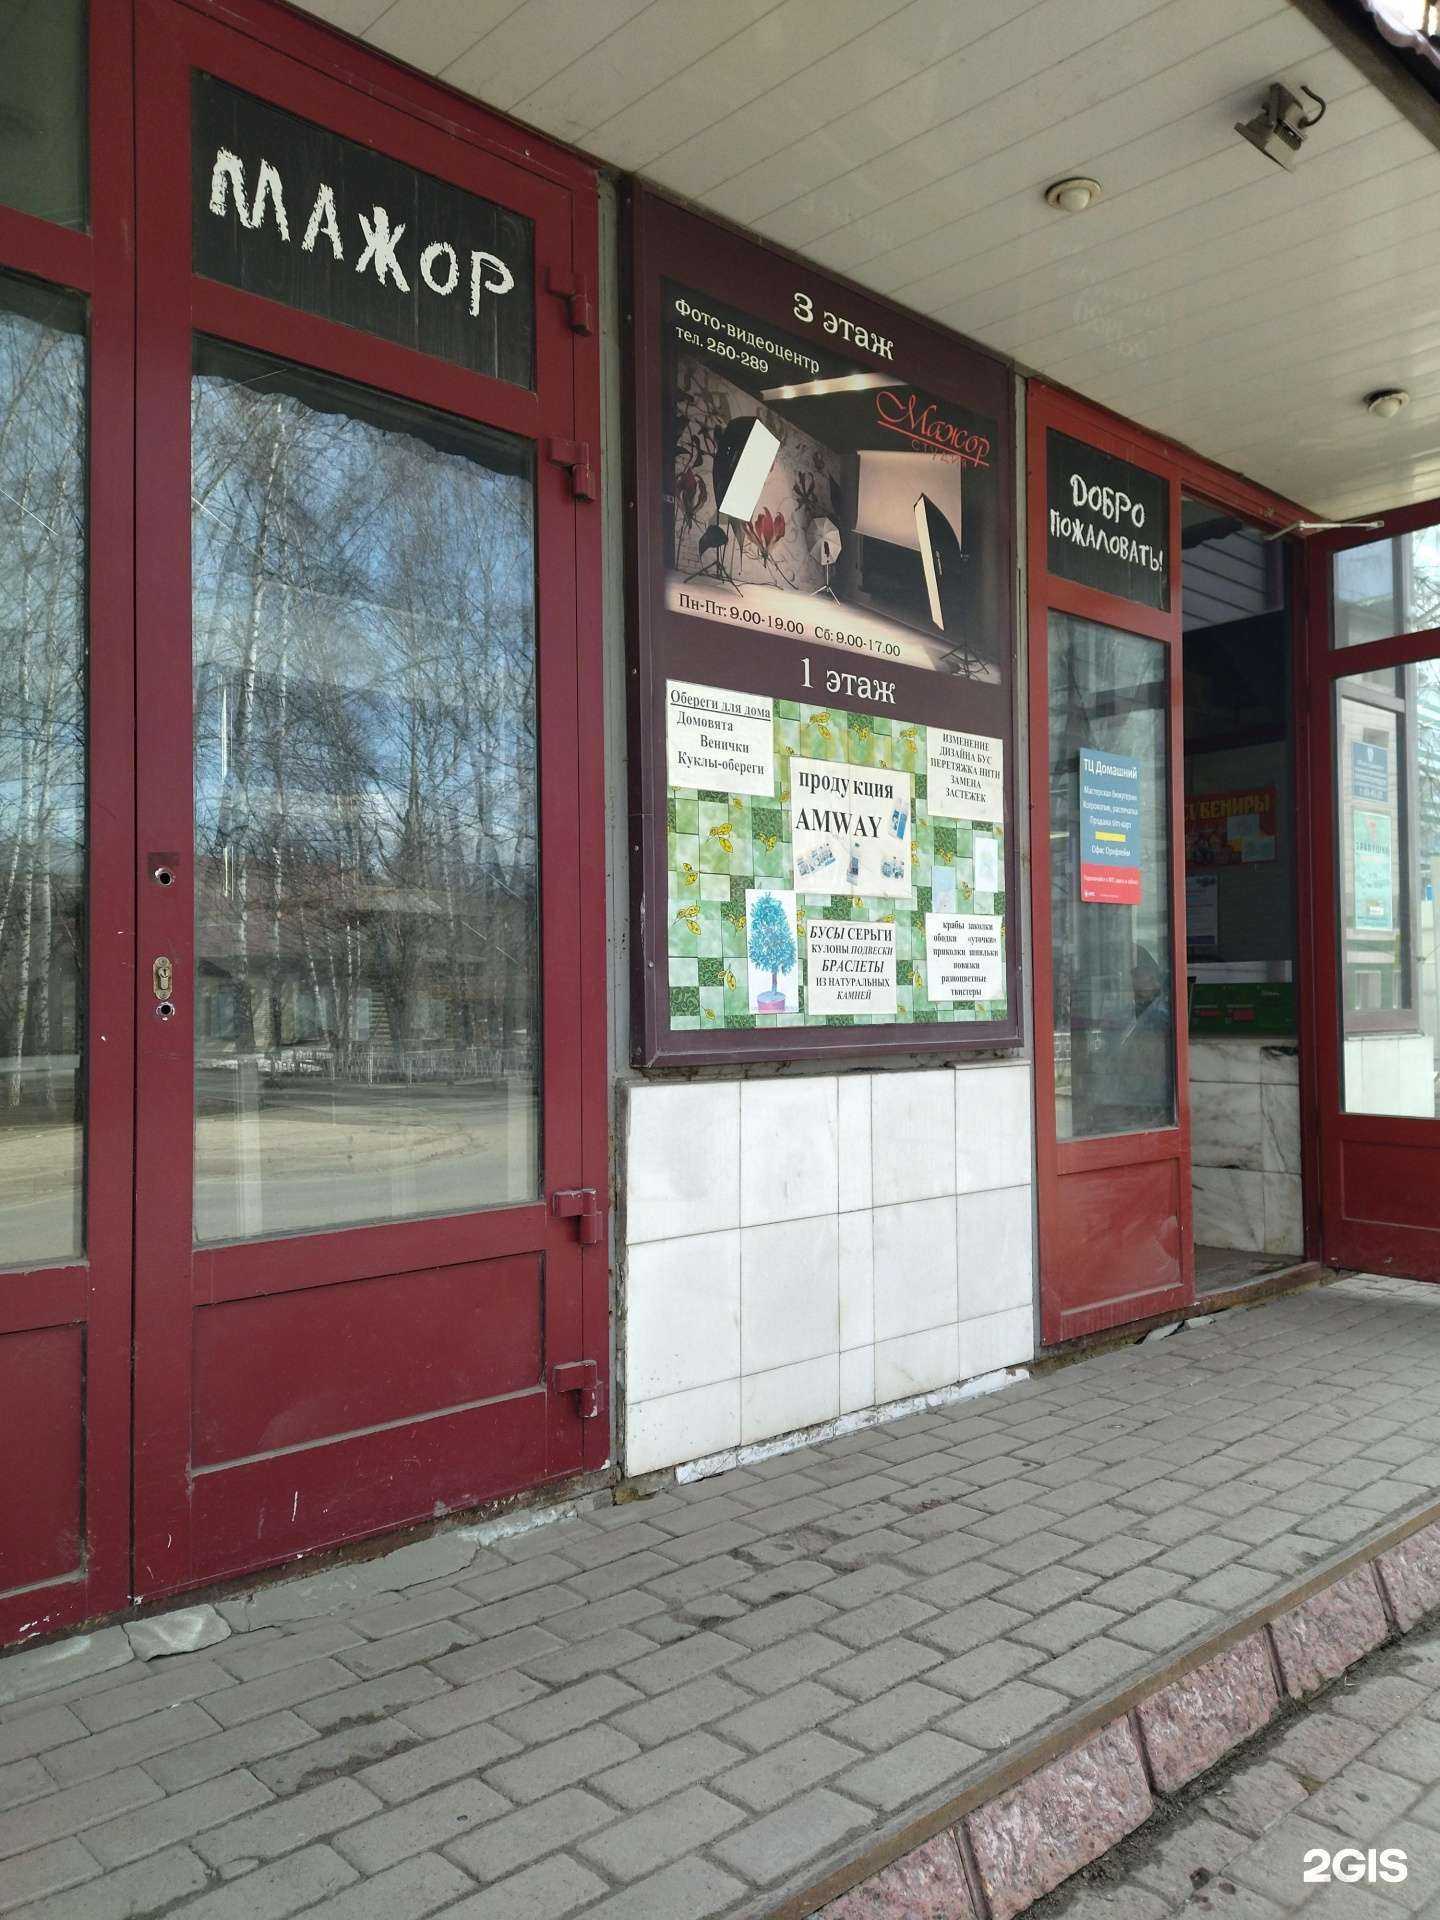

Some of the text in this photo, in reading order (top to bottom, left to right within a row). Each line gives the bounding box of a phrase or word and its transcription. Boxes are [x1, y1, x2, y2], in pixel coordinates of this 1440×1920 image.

[209, 146, 514, 317] МАЖОР
[675, 299, 820, 373] Фото-видеоцентр
[793, 291, 895, 361] 3 этаж
[675, 326, 769, 373] тел. 250-289
[876, 391, 991, 468] Мажор
[1070, 474, 1145, 529] ДОБРО
[1050, 508, 1164, 573] ПОЖАЛОВАТЬ!
[679, 593, 901, 657] Пн-Пт: 9.00-19.00 Сб: 9.00-17.00
[800, 657, 897, 704] 1 этаж
[671, 689, 771, 718] Обереги для дома
[677, 711, 733, 732] Домовята
[700, 734, 750, 754] Венички
[943, 733, 990, 752] ИЗМЕНЕНИЕ
[678, 750, 764, 775] Куклы-обереги
[939, 746, 992, 765] ДИЗАЙНА БУС
[930, 757, 1001, 780] ПЕРЕТЯЖКА НИТИ
[1083, 758, 1137, 779] ТЦ Домашний
[951, 774, 982, 790] ЗАМЕНА
[946, 787, 987, 803] ЗАСТЕЖЕК
[796, 808, 882, 838] AMWAY
[810, 925, 893, 941] БУСЫ СЕРЬГИ
[811, 944, 893, 956] КУЛОНЫ ПОДВЕСКИ
[822, 959, 884, 973] БРАСЛЕТЫ
[816, 977, 890, 987] ИЗ НАТУРАЛЬНЫХ
[837, 989, 872, 1000] КАМНЕЙ
